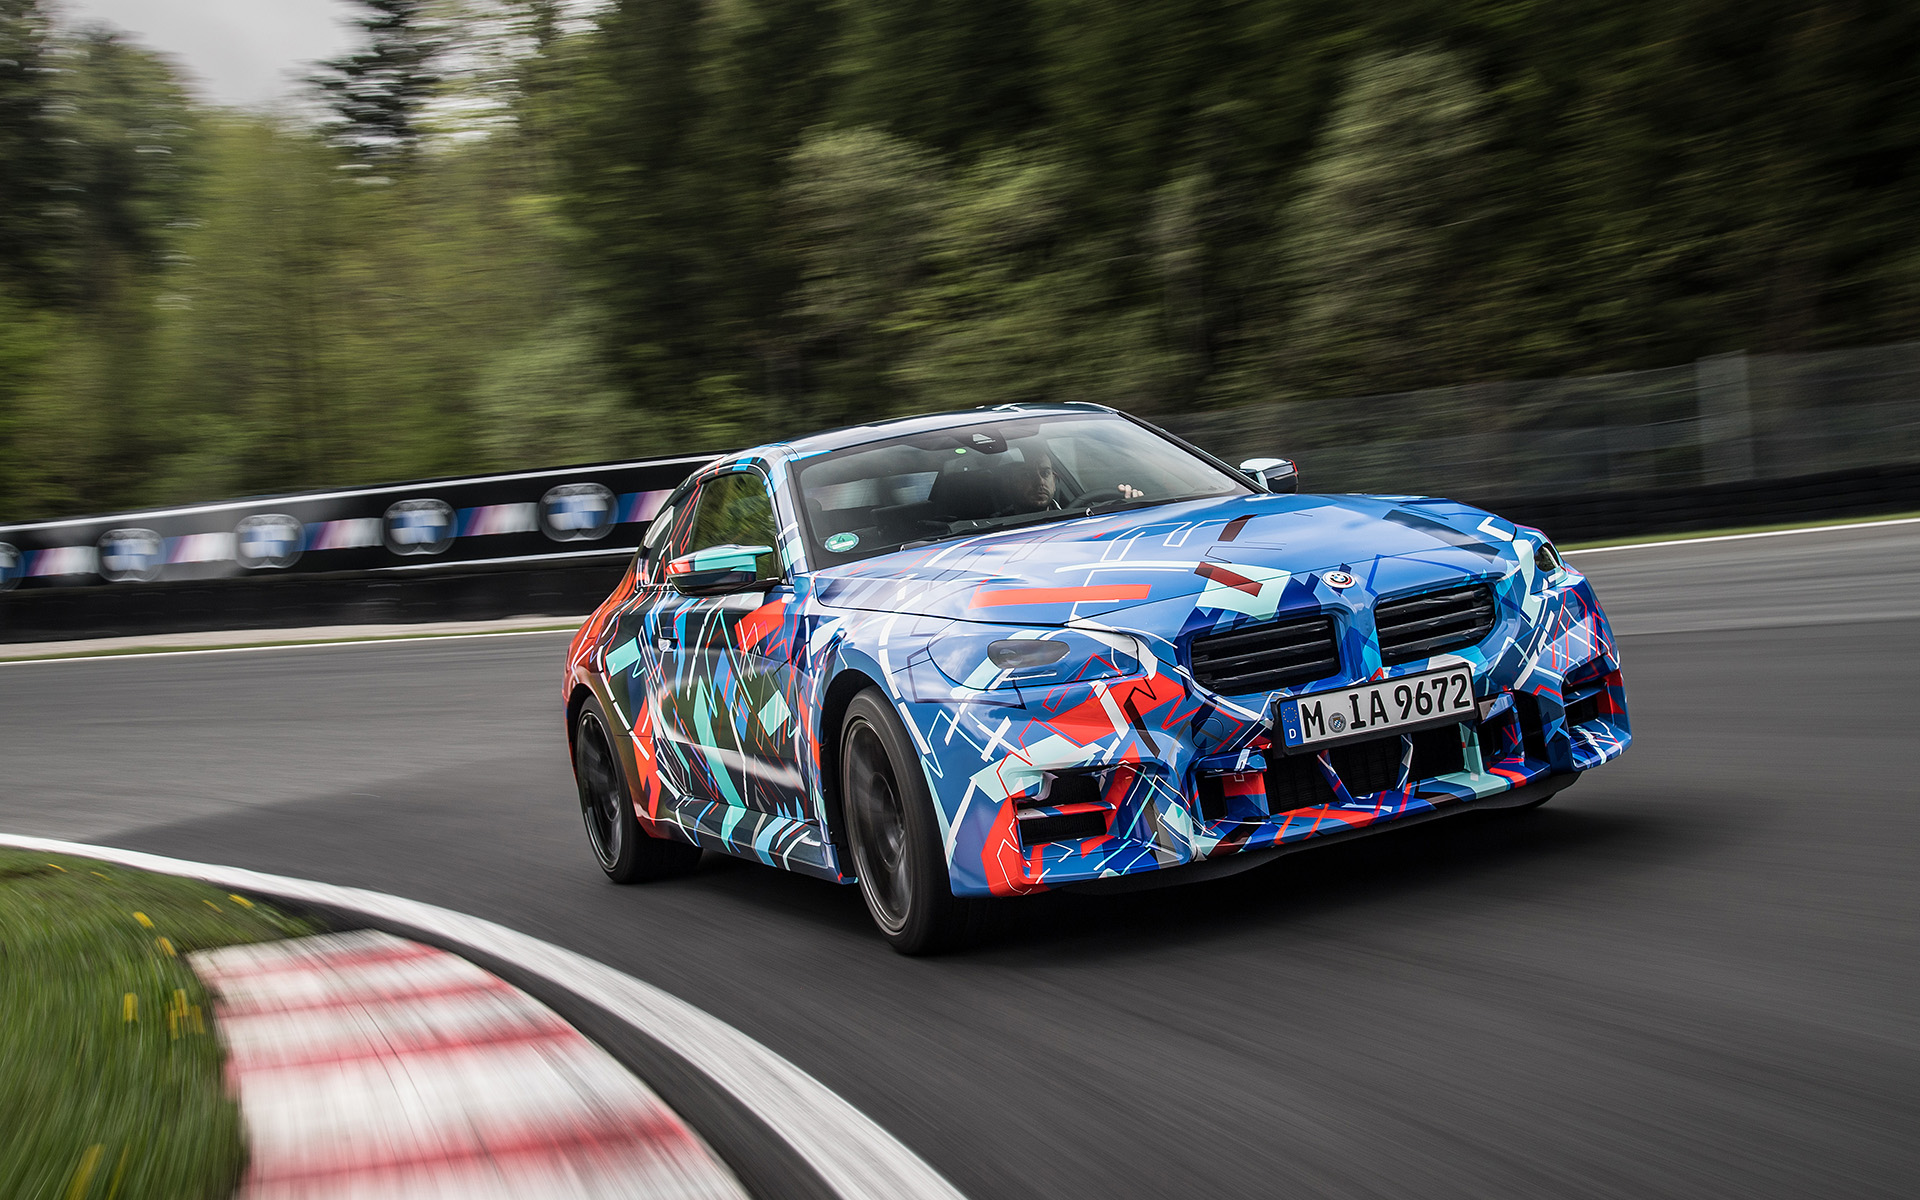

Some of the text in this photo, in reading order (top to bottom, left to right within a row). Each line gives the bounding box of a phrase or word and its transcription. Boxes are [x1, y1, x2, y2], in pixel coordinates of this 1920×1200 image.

[1301, 673, 1471, 738] M IA 9672
[1288, 728, 1297, 739] D
